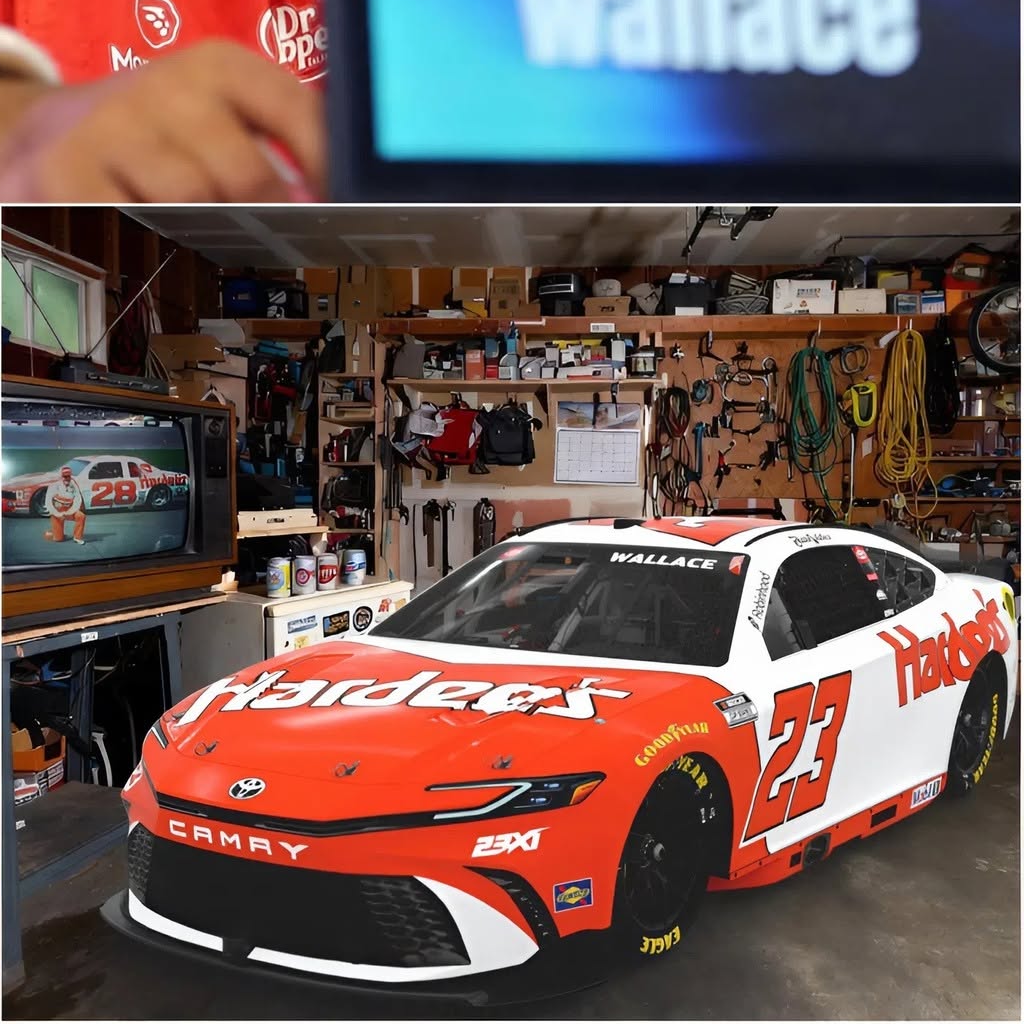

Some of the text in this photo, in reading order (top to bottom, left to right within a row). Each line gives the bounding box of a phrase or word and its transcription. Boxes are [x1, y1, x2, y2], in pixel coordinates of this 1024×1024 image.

[276, 5, 316, 41] Dr
[91, 480, 138, 508] 28
[610, 551, 718, 570] WALLACE
[742, 670, 853, 846] 23
[168, 820, 309, 861] CAMRY
[471, 826, 550, 858] 23XI
